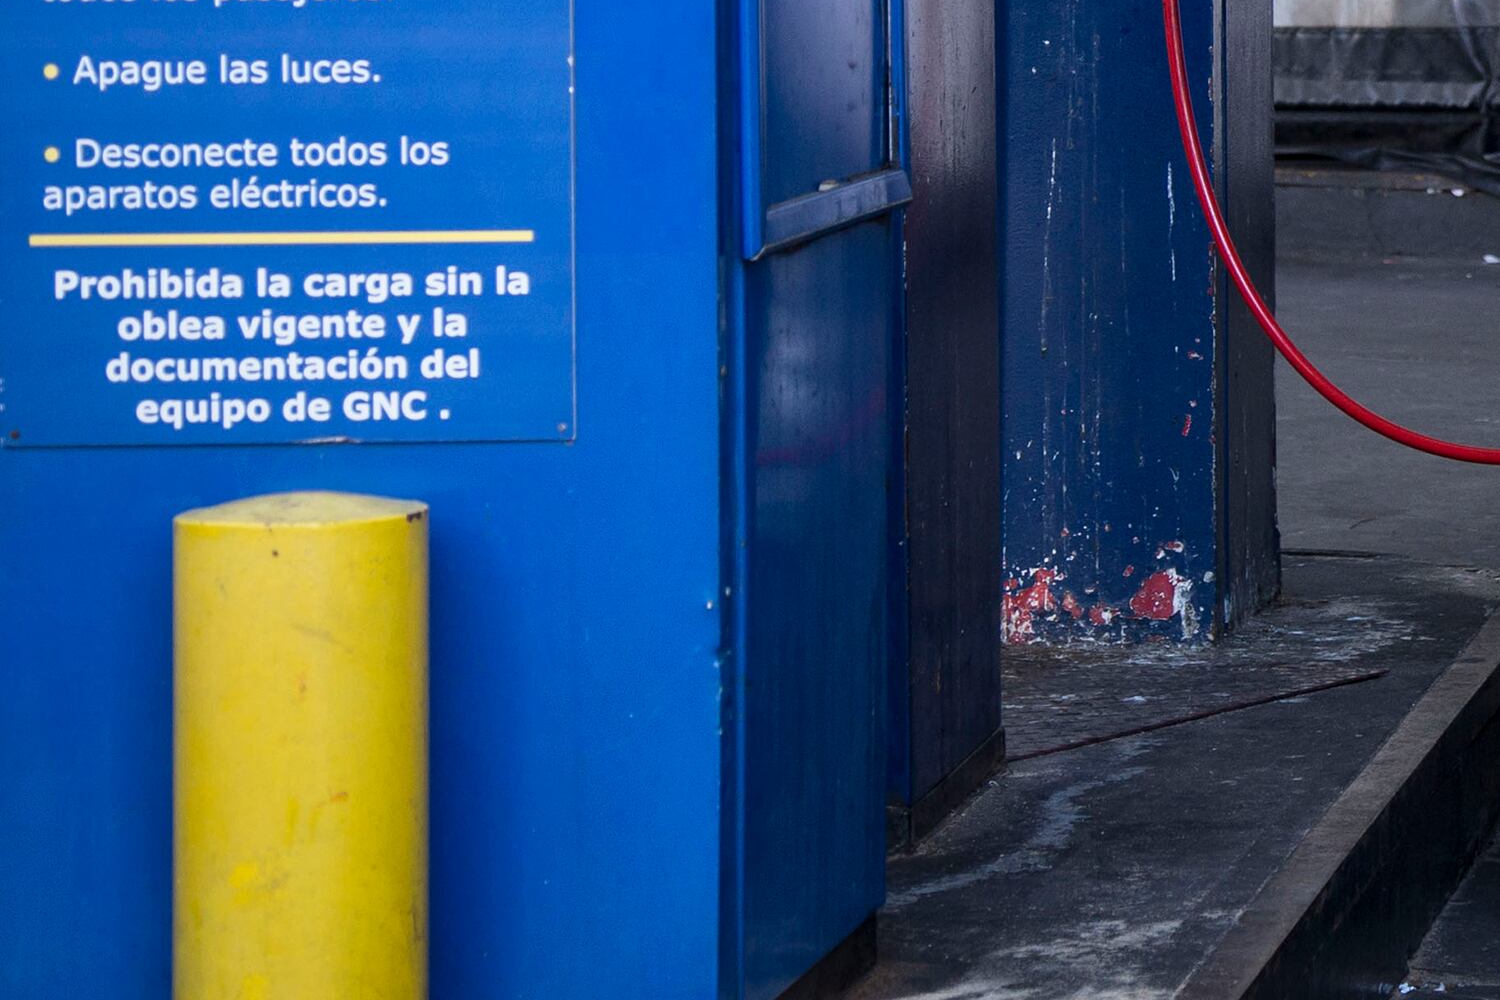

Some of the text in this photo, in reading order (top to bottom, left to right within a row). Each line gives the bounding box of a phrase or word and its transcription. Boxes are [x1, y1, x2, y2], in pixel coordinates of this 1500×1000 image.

[74, 54, 381, 91] Apague las luces.
[77, 136, 449, 167] Desconecte todos los
[44, 176, 387, 215] aparatos eléctricos.
[55, 265, 529, 304] Prohibida la carga sin la
[118, 307, 466, 345] oblea vigente y la
[106, 348, 479, 381] documentación del
[136, 392, 270, 429] equipo
[283, 392, 330, 421] de
[343, 391, 426, 420] GNC
